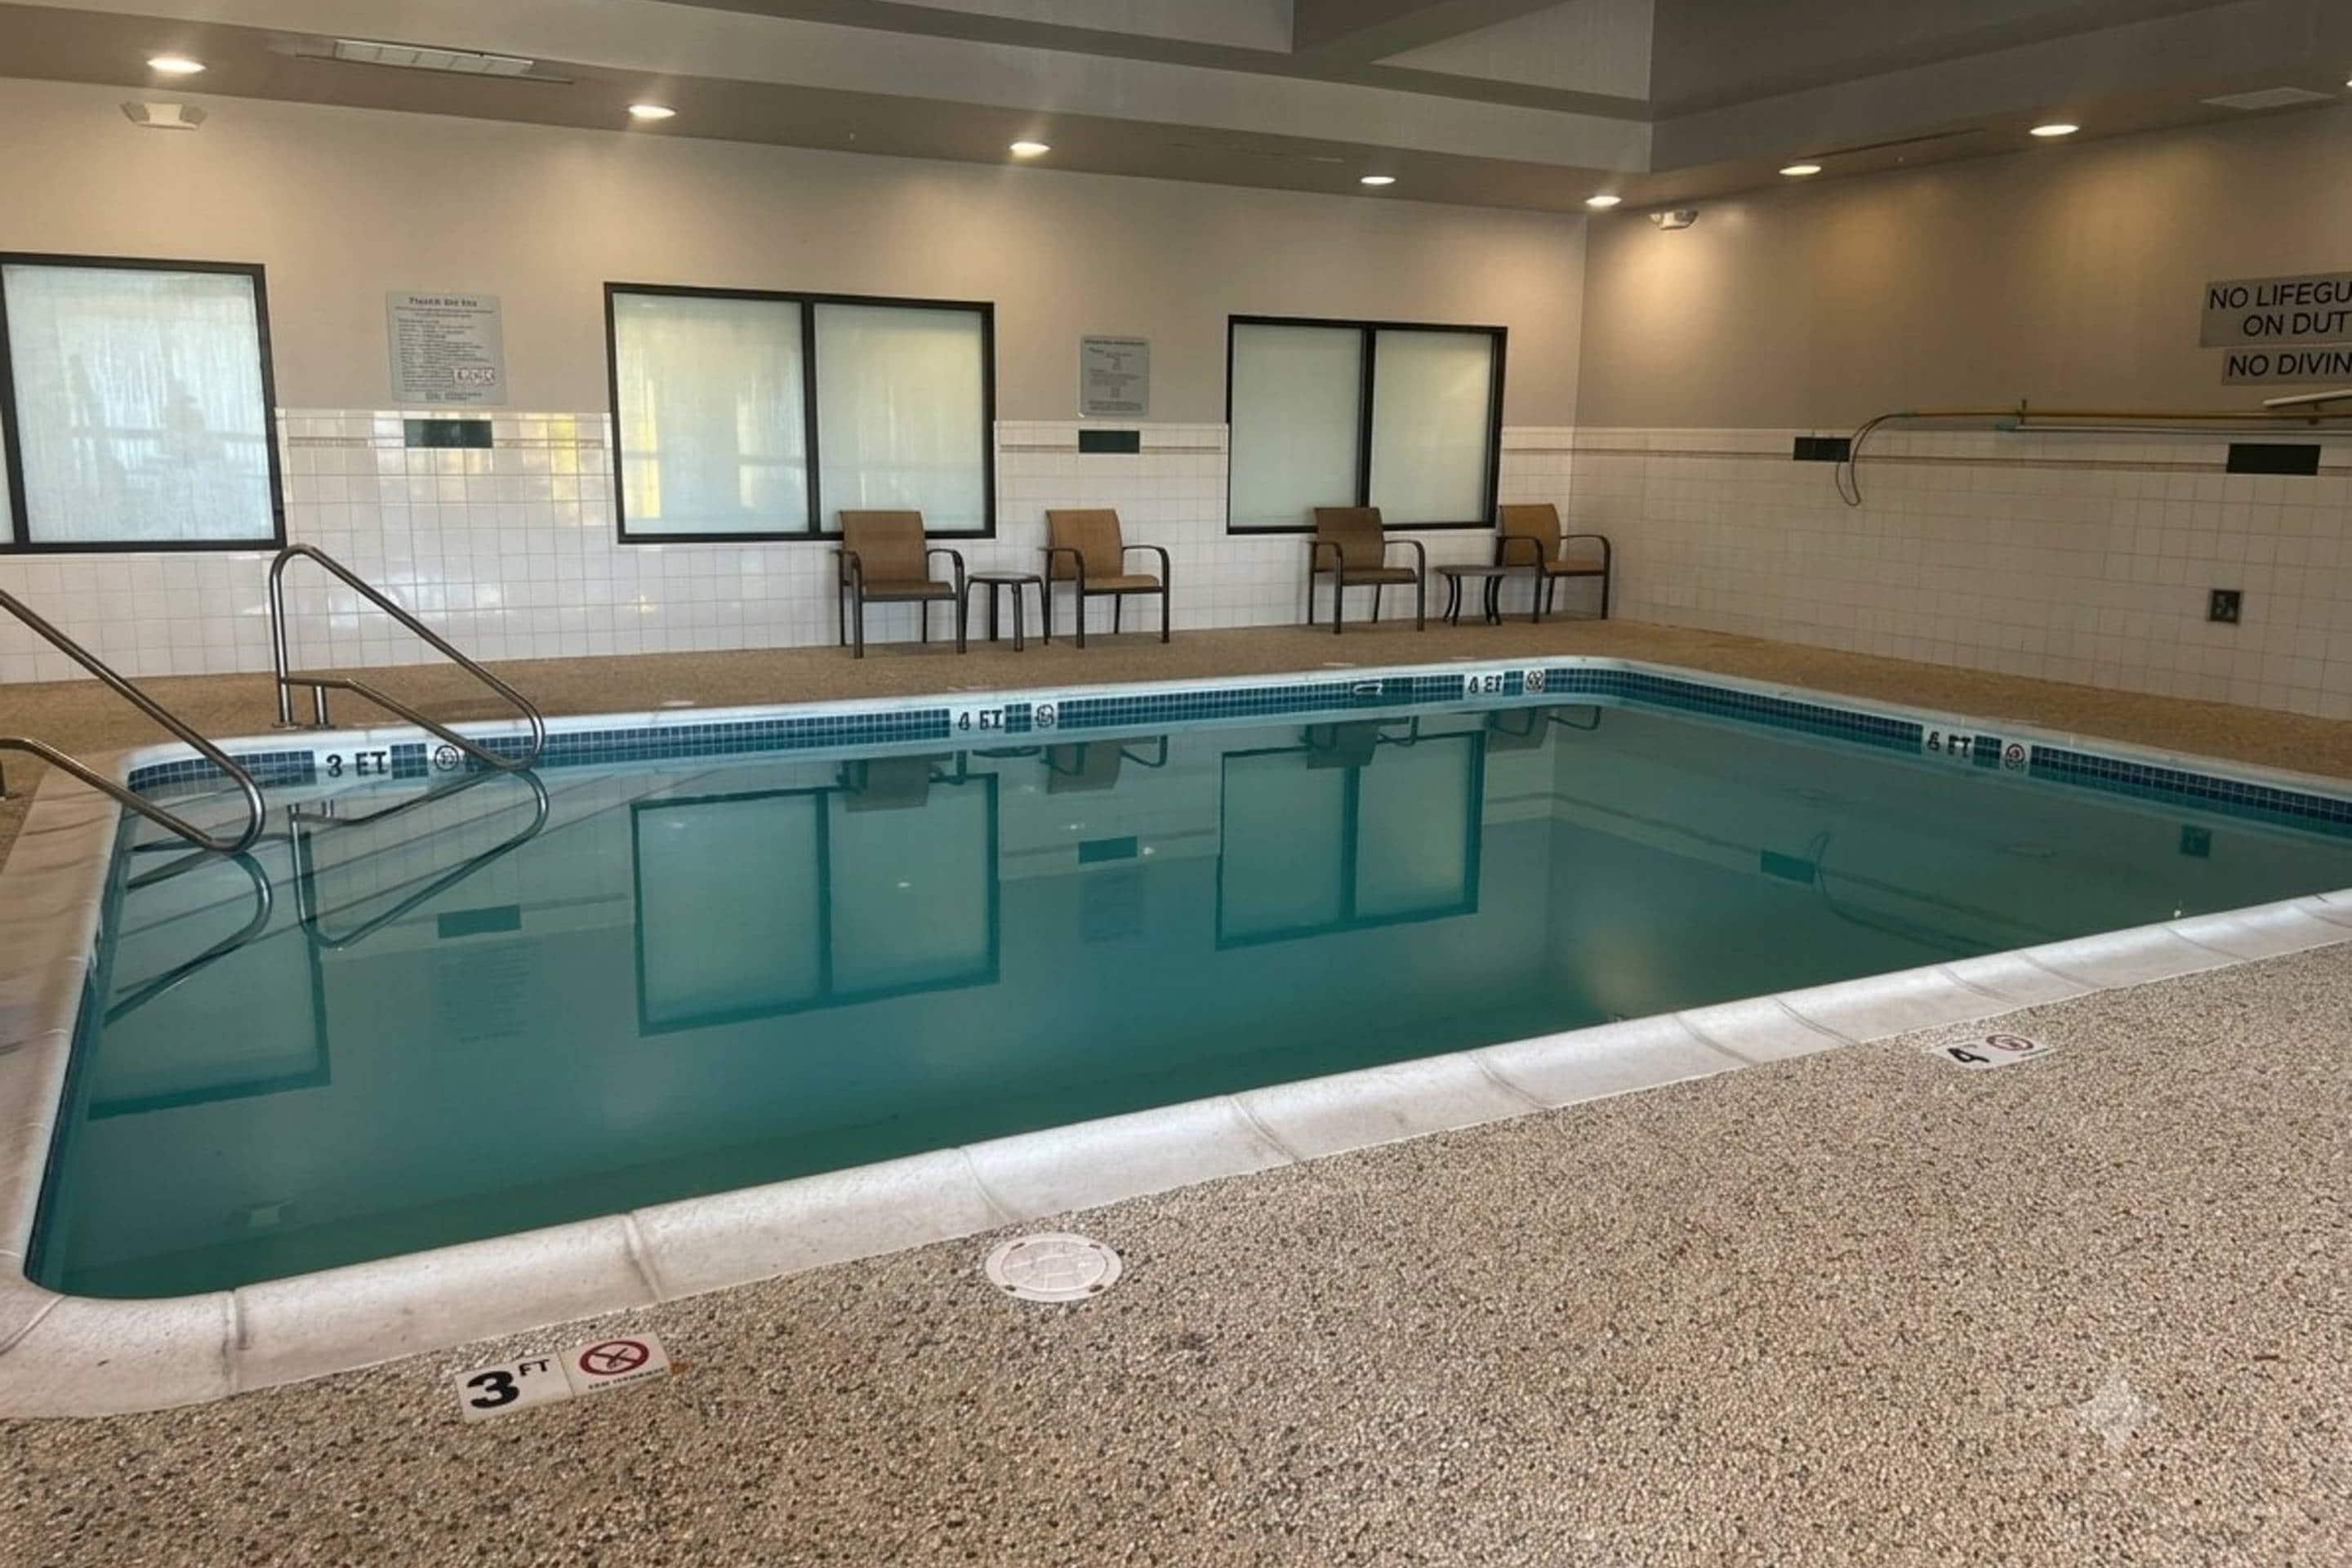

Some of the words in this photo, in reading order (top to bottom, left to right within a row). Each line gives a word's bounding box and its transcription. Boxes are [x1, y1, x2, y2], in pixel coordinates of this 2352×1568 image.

[2209, 287, 2248, 310] NO
[2256, 281, 2352, 306] LIFEGU
[2243, 314, 2284, 336] ON
[2292, 310, 2352, 335] DUT
[2228, 354, 2270, 377] NO
[2277, 352, 2352, 376] DIVIN
[327, 754, 342, 777] 3
[1947, 1048, 1990, 1062] 4
[466, 1370, 519, 1409] 3
[519, 1359, 550, 1377] FT
